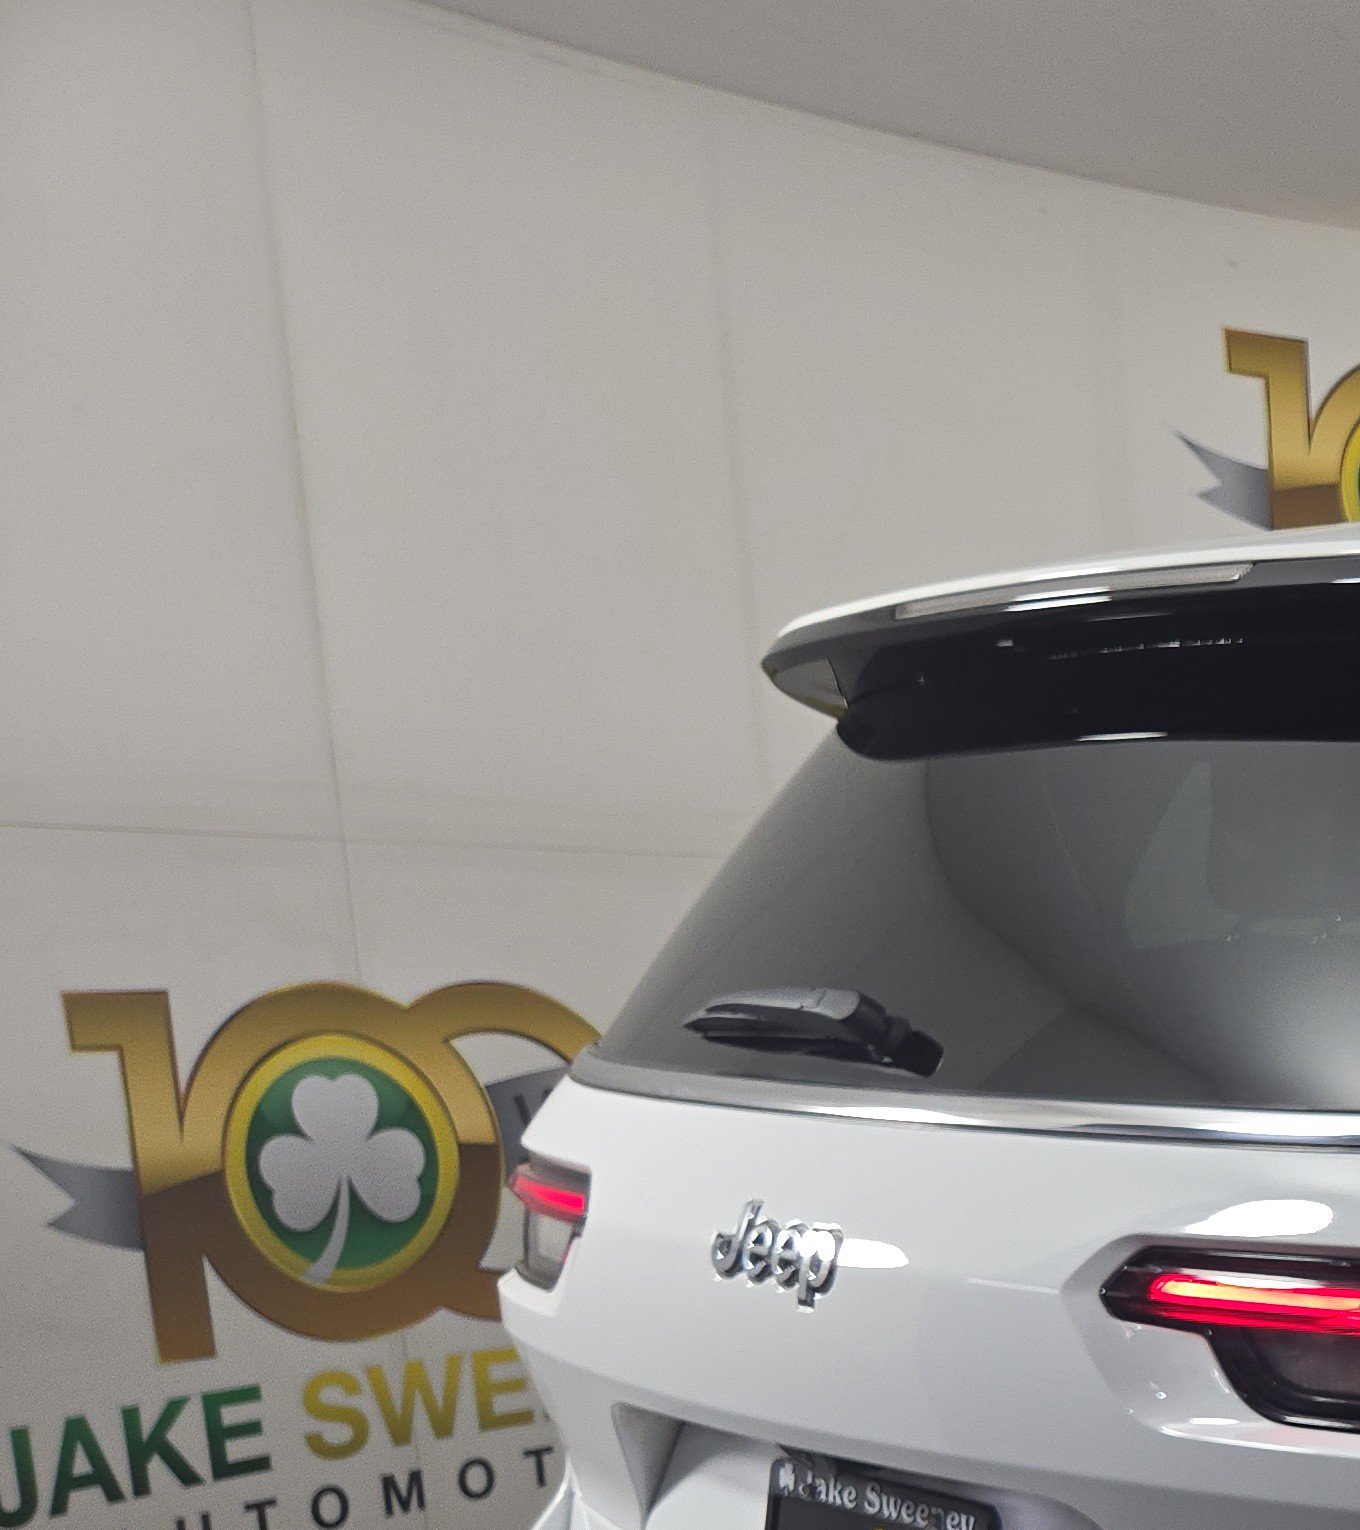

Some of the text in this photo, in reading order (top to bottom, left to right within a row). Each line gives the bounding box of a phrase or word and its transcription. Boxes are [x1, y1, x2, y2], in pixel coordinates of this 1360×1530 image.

[711, 1199, 844, 1312] Jeep
[0, 1348, 549, 1528] JAKE SWE
